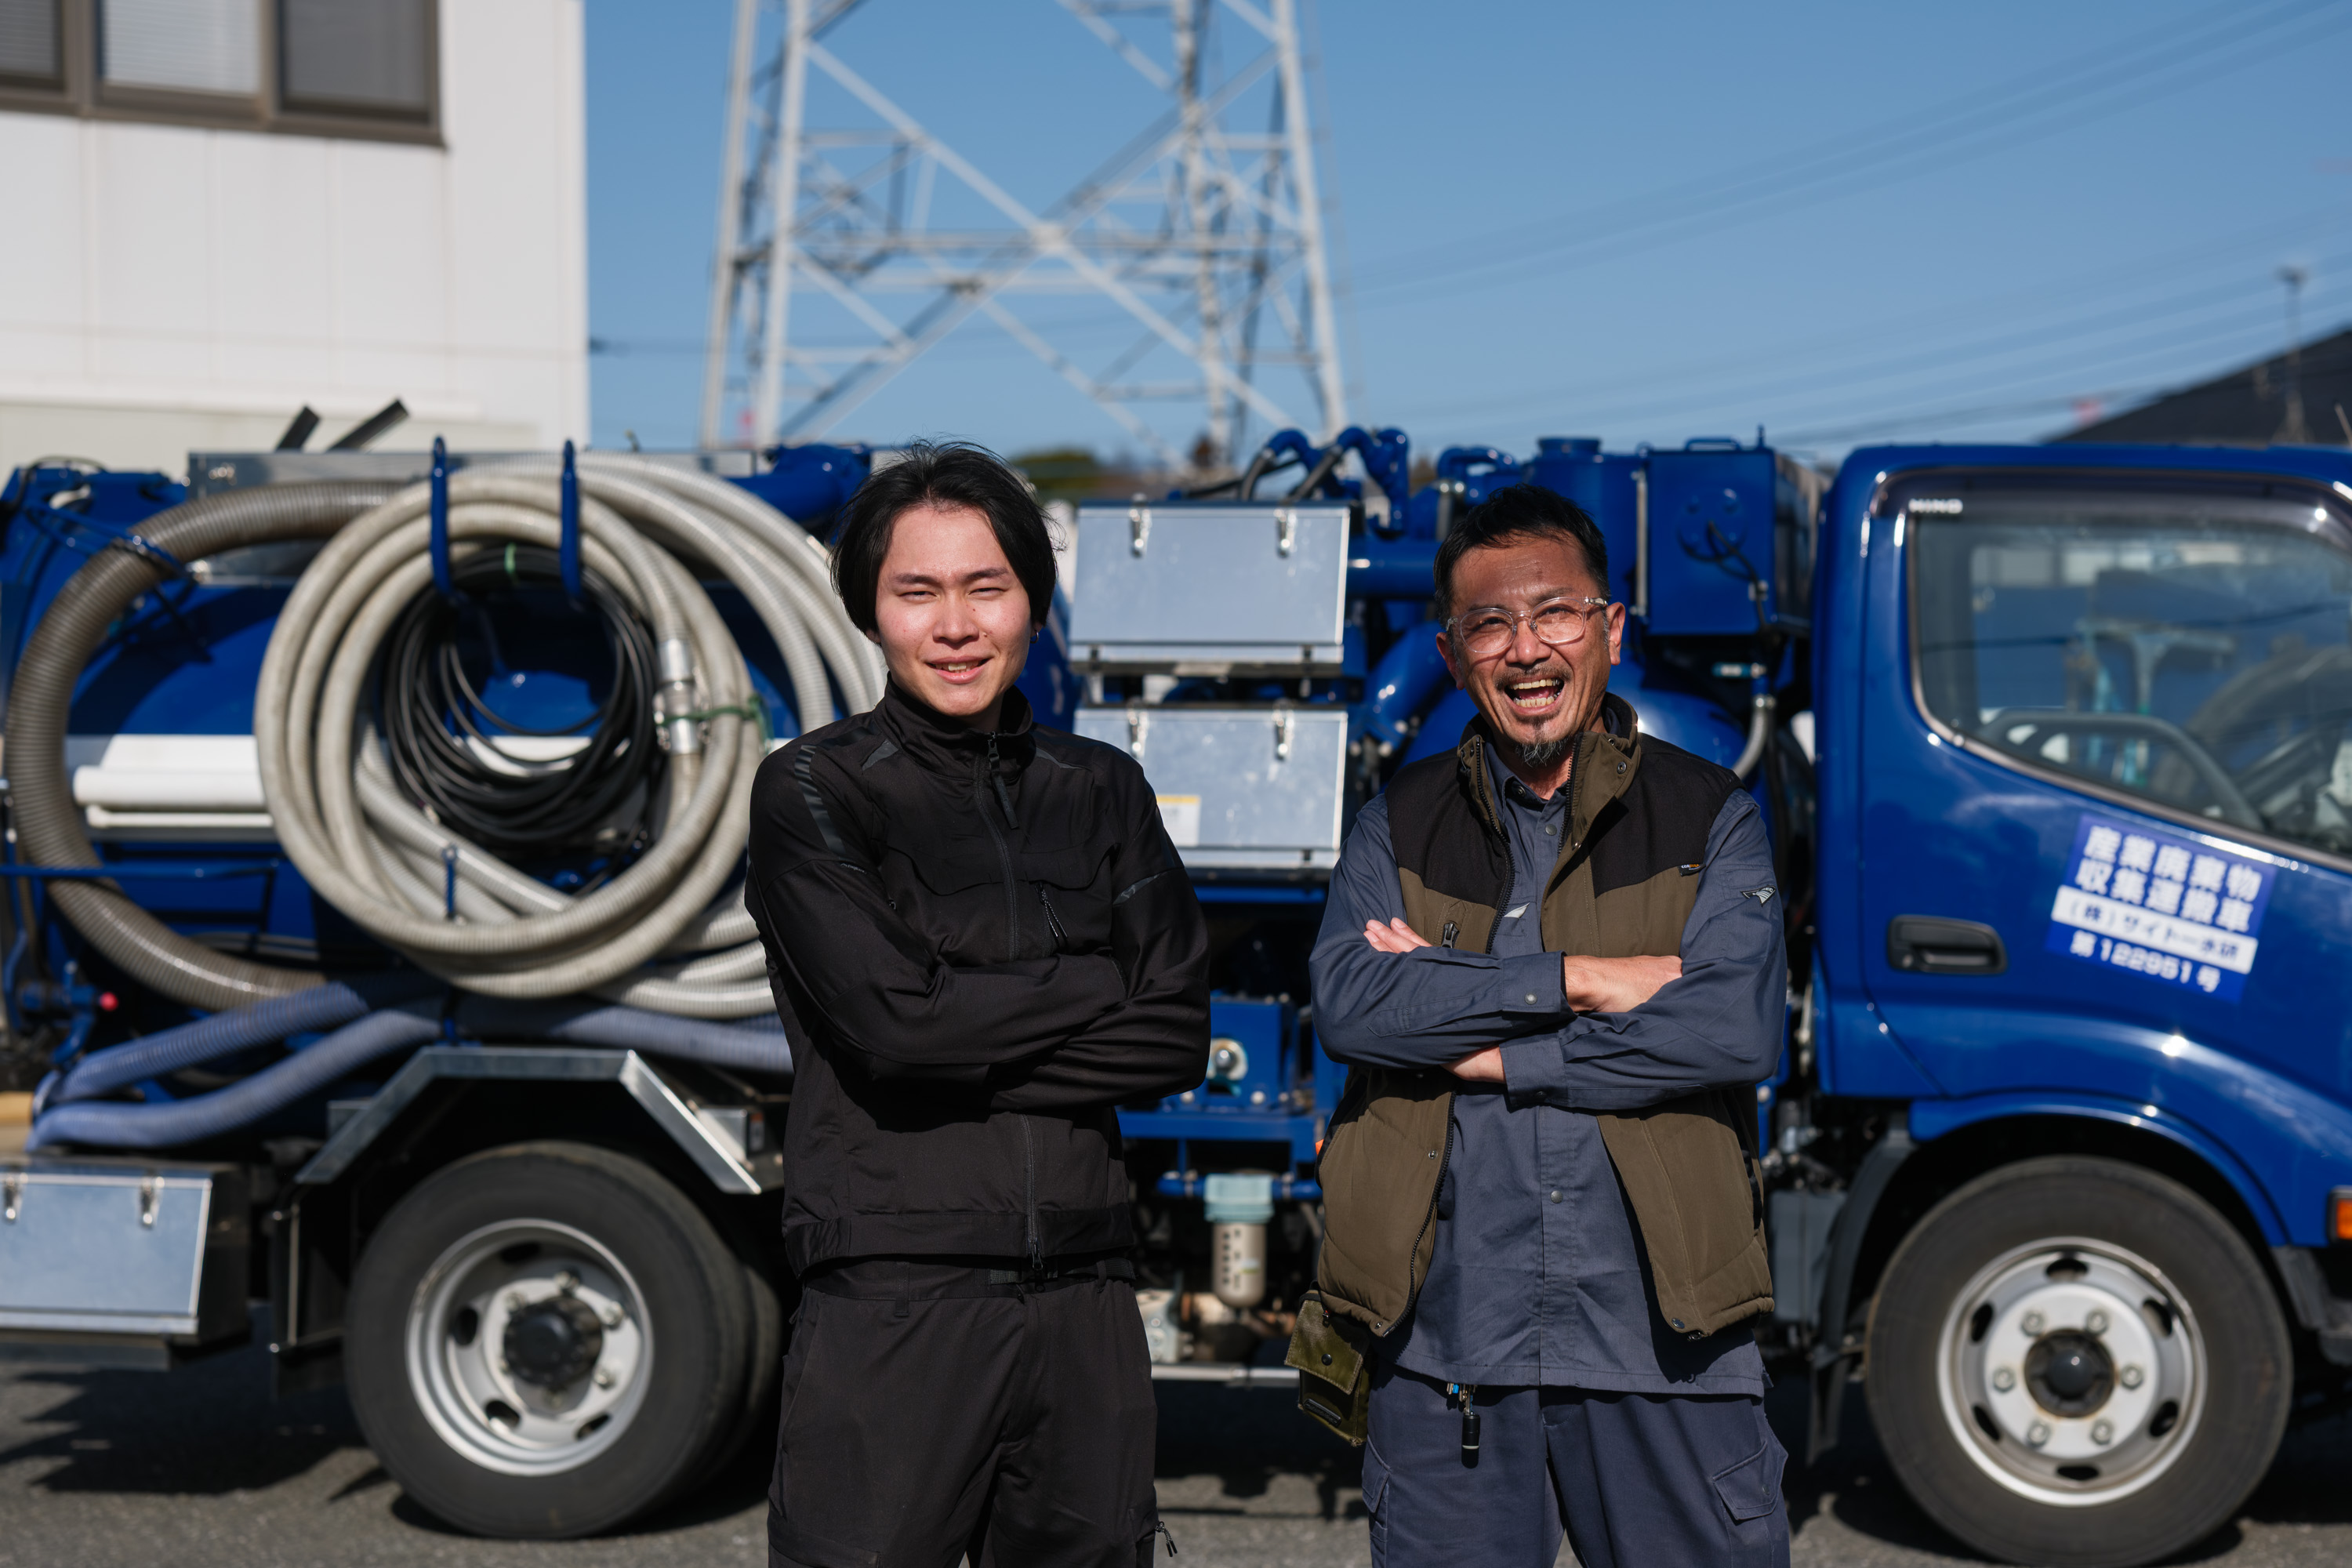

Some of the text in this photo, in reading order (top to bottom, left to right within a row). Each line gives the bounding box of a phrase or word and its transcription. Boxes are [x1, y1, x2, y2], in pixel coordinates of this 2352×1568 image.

[1908, 498, 1963, 514] HINO
[2074, 858, 2253, 932] 収集運搬車
[2083, 825, 2263, 902] 産業廃棄物
